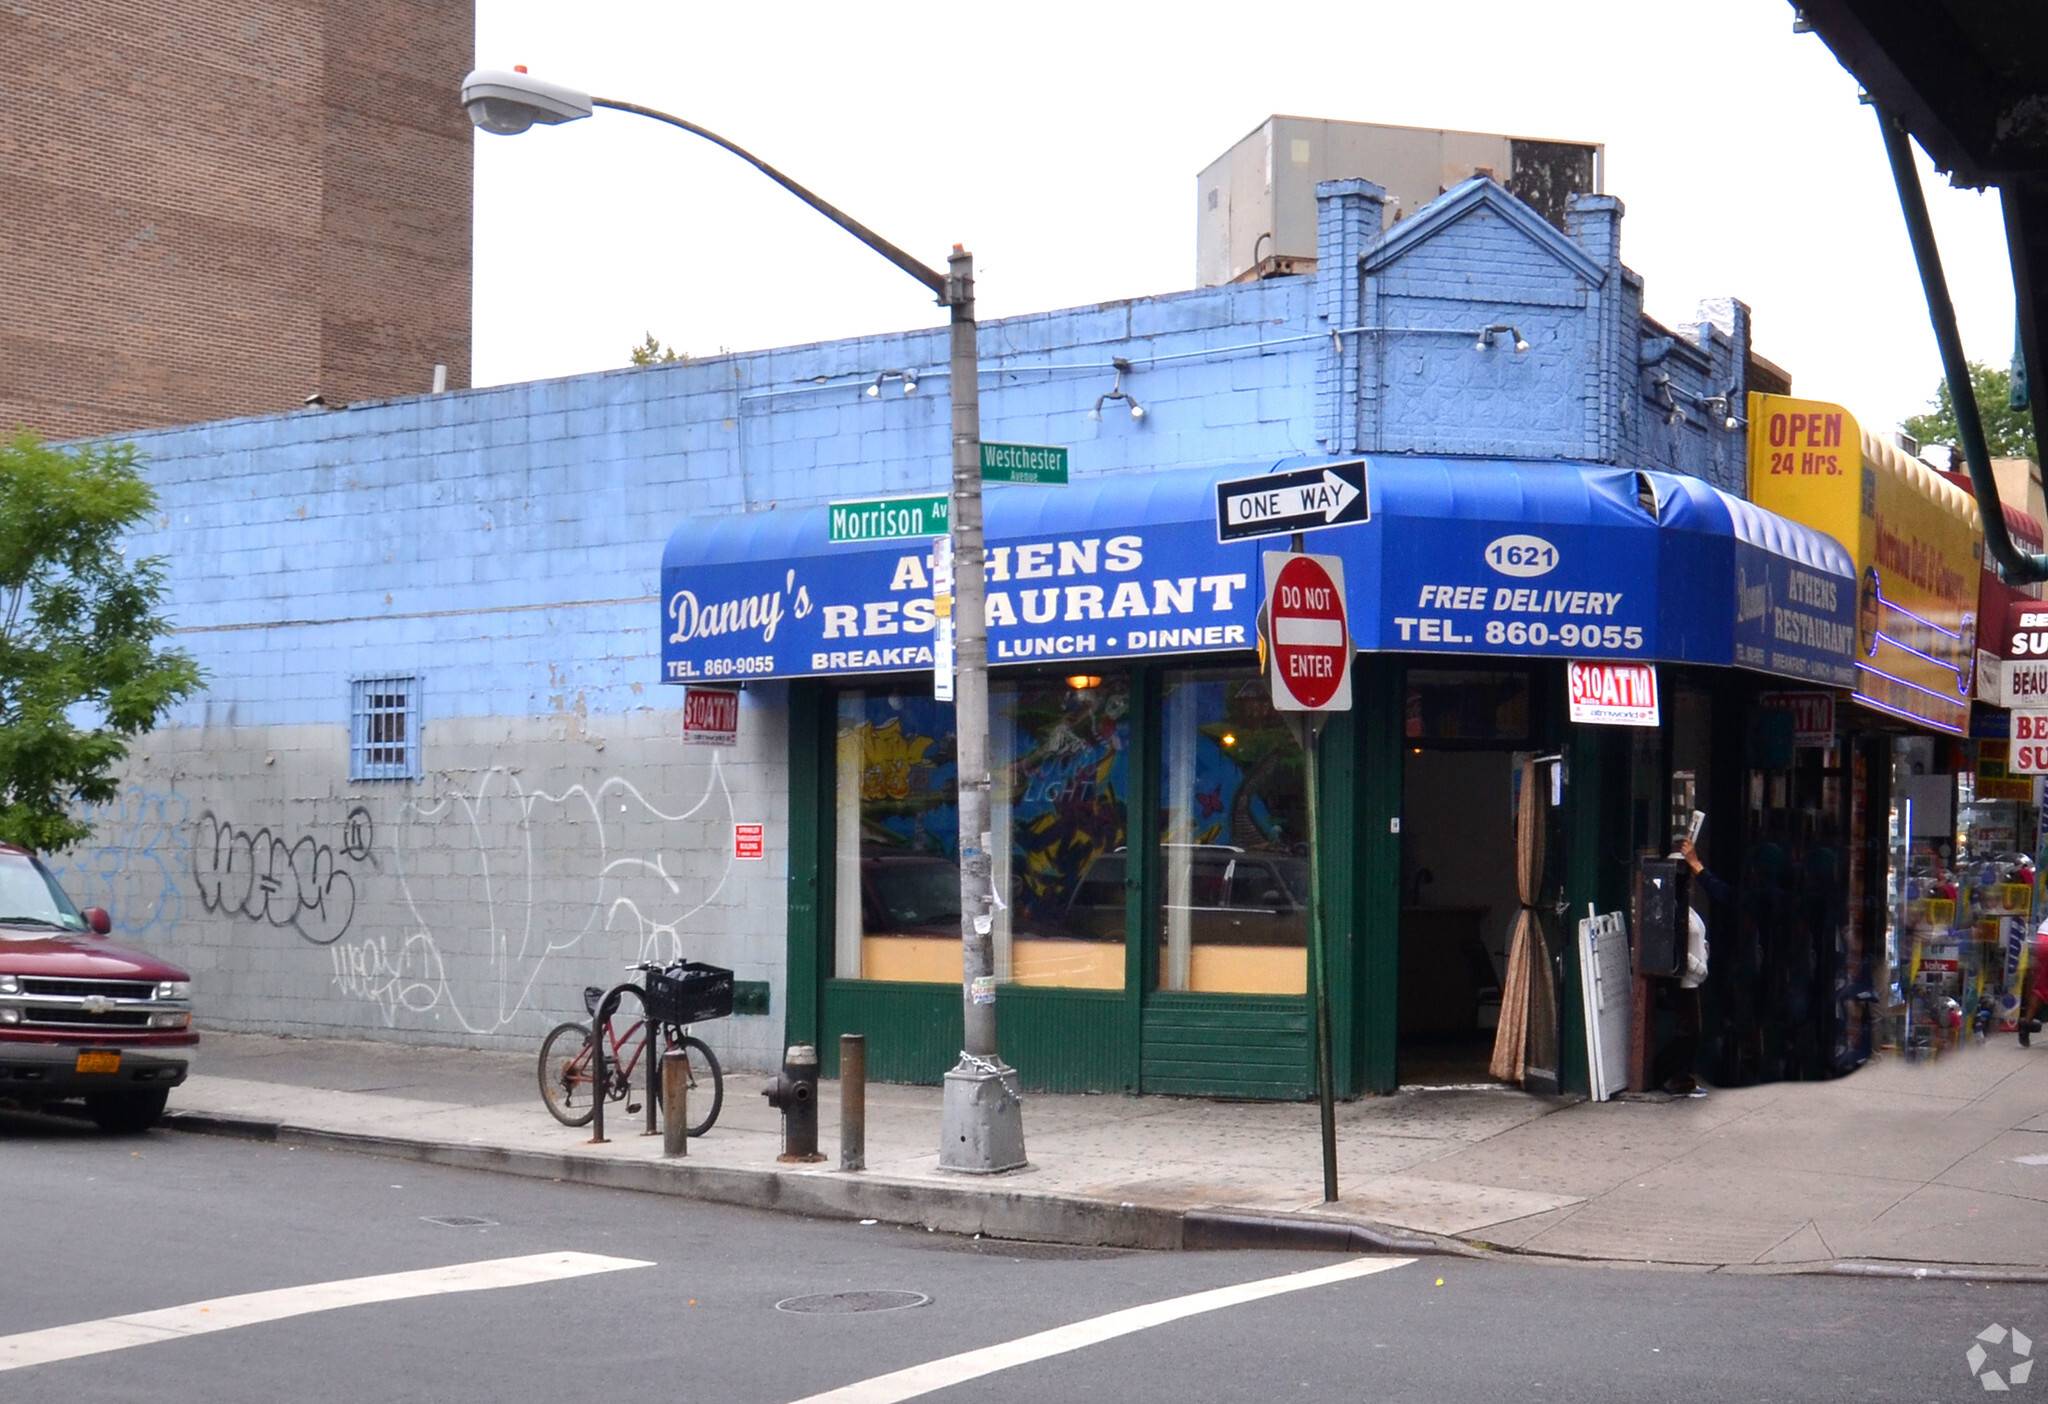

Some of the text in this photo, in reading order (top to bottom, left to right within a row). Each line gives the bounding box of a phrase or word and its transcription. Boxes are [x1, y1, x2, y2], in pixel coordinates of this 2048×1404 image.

[1769, 413, 1842, 447] OPEN
[984, 445, 1062, 471] Westchester
[1770, 452, 1842, 475] 24 Hrs.
[1010, 470, 1038, 482] Avenue
[1239, 483, 1344, 519] ONE WAY
[833, 504, 923, 538] Morrison
[890, 536, 1143, 590] AHENS
[1490, 545, 1554, 566] 1621
[669, 569, 813, 643] Danny's
[1281, 585, 1331, 610] DO NOT
[1418, 585, 1623, 615] FREE DELIVERY
[1789, 568, 1837, 613] ATHENS
[822, 573, 1247, 640] RESAURANT
[998, 634, 1095, 658] LUNCH
[1127, 624, 1246, 650] DINNER
[1394, 617, 1644, 649] TEL. 860-9055
[667, 656, 774, 678] TEL. 860-9055
[1290, 654, 1333, 678] ENTER
[1024, 781, 1095, 802] LIGHT
